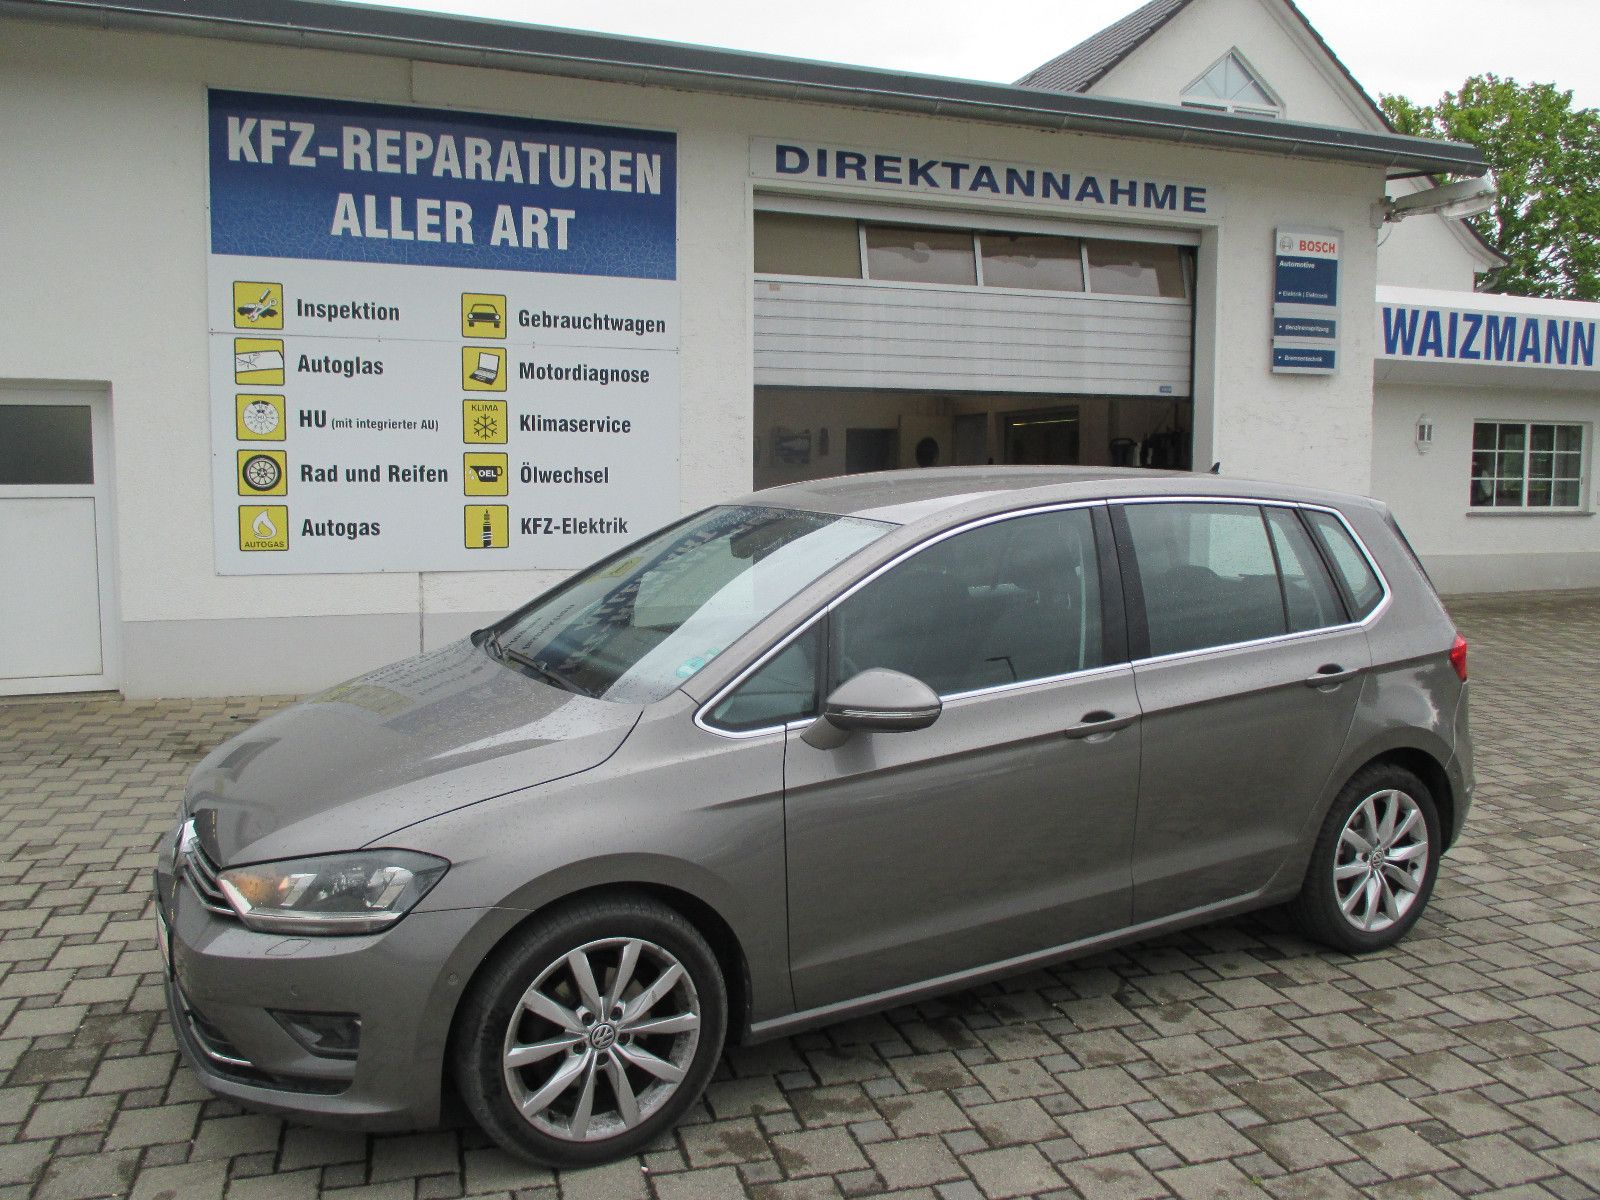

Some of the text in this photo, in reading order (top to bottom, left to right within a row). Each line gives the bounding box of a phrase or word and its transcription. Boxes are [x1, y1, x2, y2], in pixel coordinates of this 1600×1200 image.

[227, 116, 662, 195] KFZ-REPARATUREN
[775, 144, 1207, 214] DIREKTANNAHME
[331, 193, 576, 251] ALLER ART
[1299, 240, 1336, 254] BOSCH
[1279, 260, 1315, 269] Automotive
[297, 299, 400, 322] Inspektion
[518, 309, 666, 336] Gebrauchtwagen
[1382, 307, 1596, 366] WAIZMANN
[298, 354, 384, 378] Autoglas
[519, 362, 650, 385] Motordiagnose
[471, 404, 499, 412] KLIMA
[299, 409, 439, 432] HU (mit integrierter AU)
[519, 414, 632, 434] Klimaservice
[301, 464, 449, 483] Rad und Reifen
[478, 469, 497, 478] OEL
[520, 461, 609, 484] Ölwechsel
[301, 518, 381, 540] Autogas
[520, 517, 629, 535] KFZ-Elektrik
[244, 540, 285, 549] AUTOGAS
